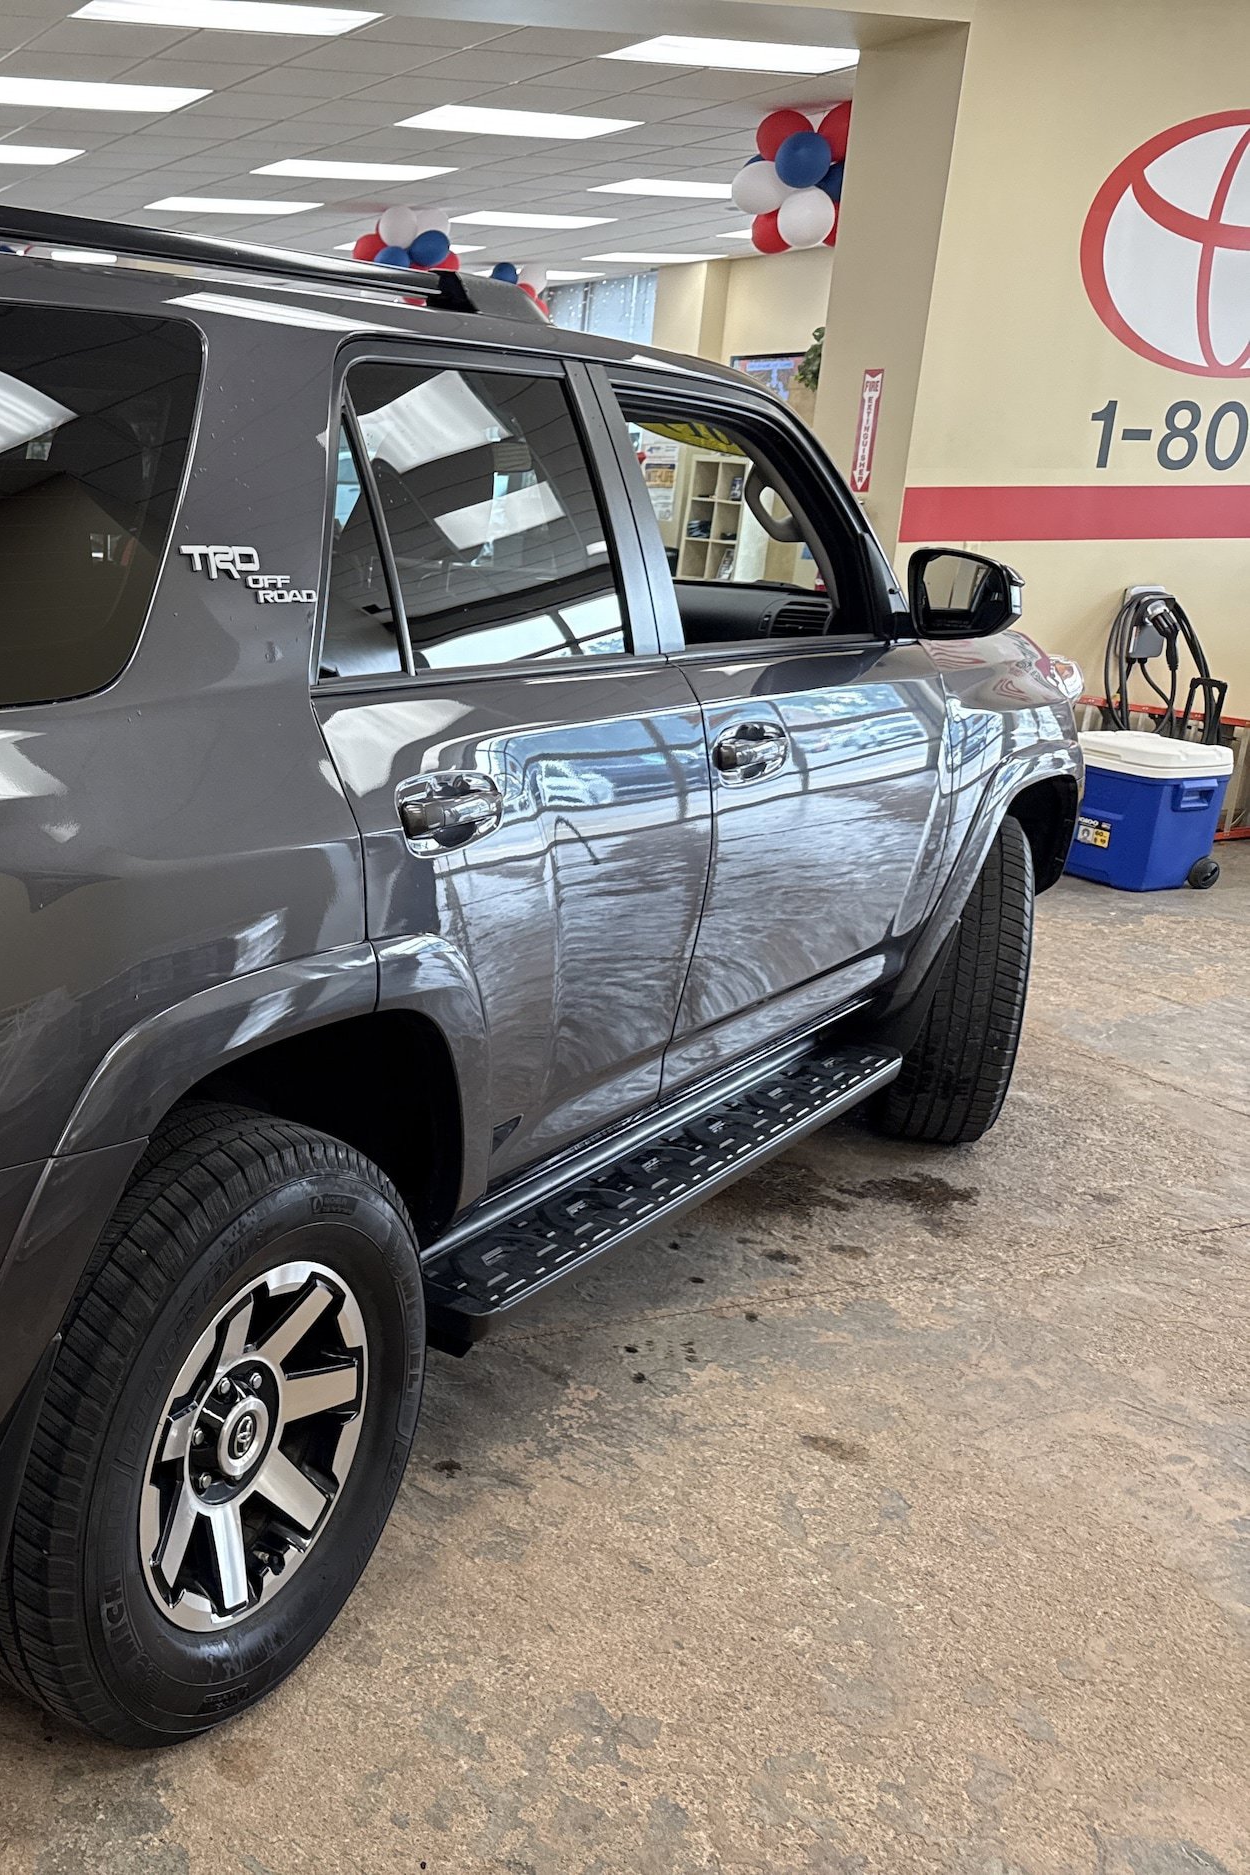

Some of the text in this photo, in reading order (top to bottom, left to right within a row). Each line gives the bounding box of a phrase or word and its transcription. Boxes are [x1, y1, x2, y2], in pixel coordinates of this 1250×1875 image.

[864, 380, 880, 393] FIRE
[857, 396, 874, 483] EXTINGUISHER
[179, 545, 261, 580] TRD
[245, 575, 291, 589] OFF
[257, 589, 318, 604] ROAD
